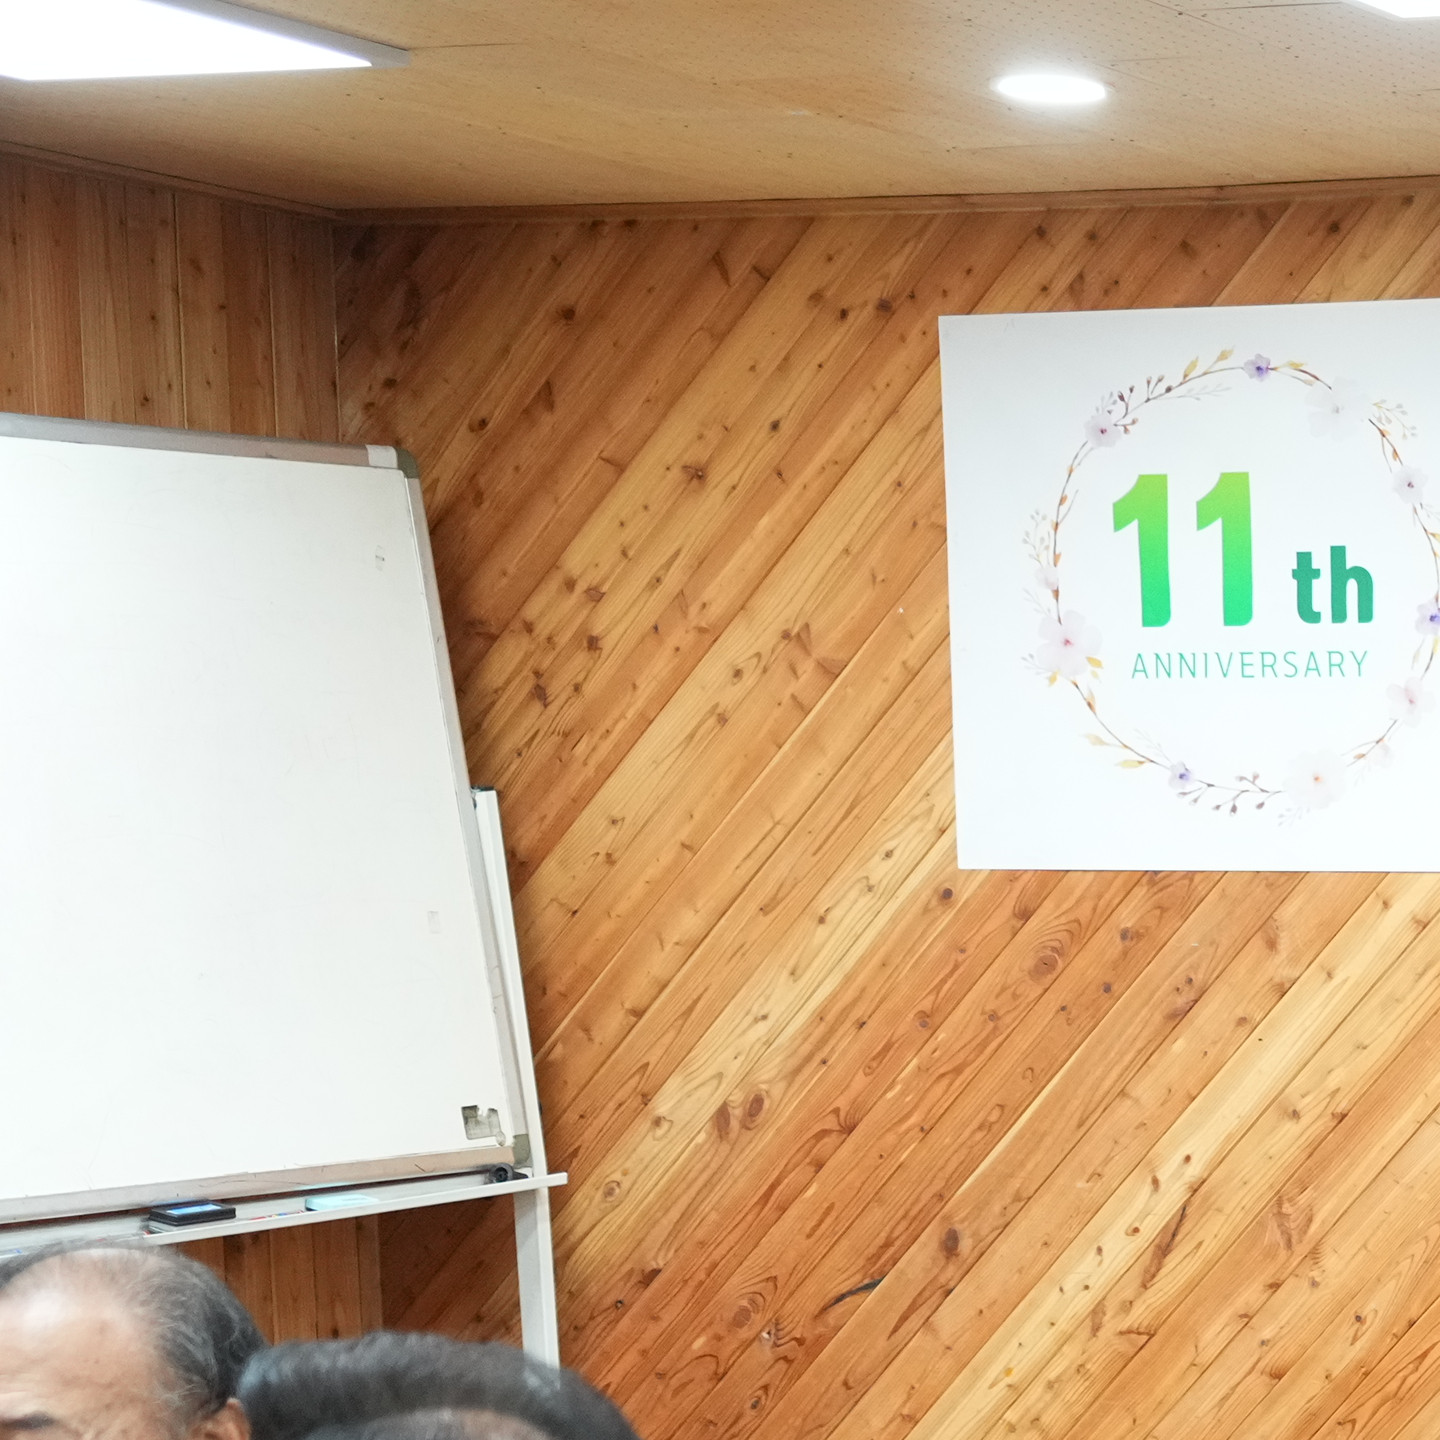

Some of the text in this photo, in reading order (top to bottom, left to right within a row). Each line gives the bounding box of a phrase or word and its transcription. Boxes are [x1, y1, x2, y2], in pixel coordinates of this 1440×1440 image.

[1112, 471, 1375, 628] 11 th
[1131, 650, 1369, 680] ANNIVERSARY
